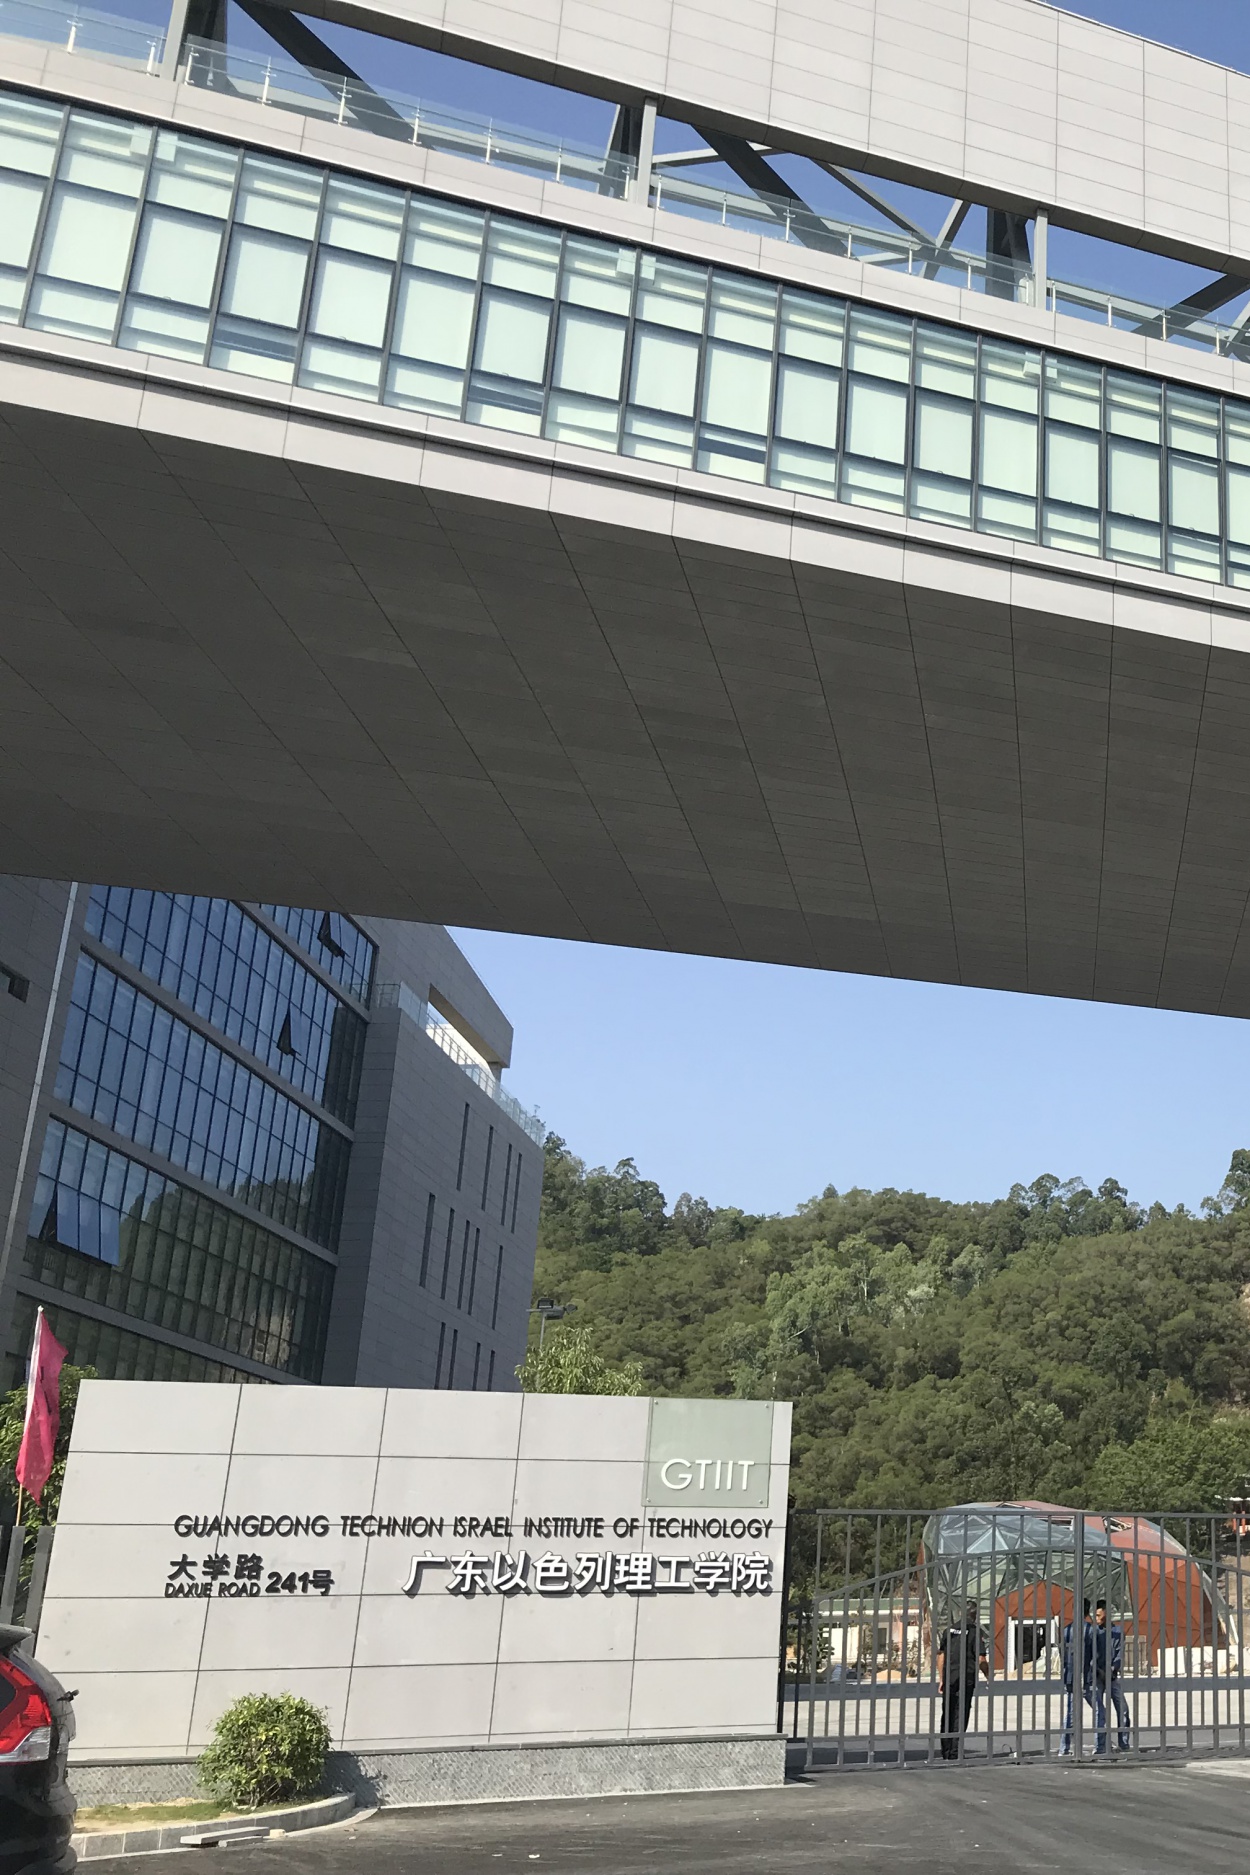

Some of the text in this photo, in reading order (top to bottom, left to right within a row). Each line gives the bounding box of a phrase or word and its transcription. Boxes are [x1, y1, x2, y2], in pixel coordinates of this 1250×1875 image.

[660, 1458, 755, 1490] GTIIT
[173, 1514, 774, 1539] GUANGDONG TECHNION ISRAEL INSTITUTE OF TECHNOLOGY
[164, 1582, 261, 1598] DAXUE ROAD
[168, 1553, 335, 1597] 大学路 241号
[402, 1550, 773, 1599] 广东以色列理工学院
